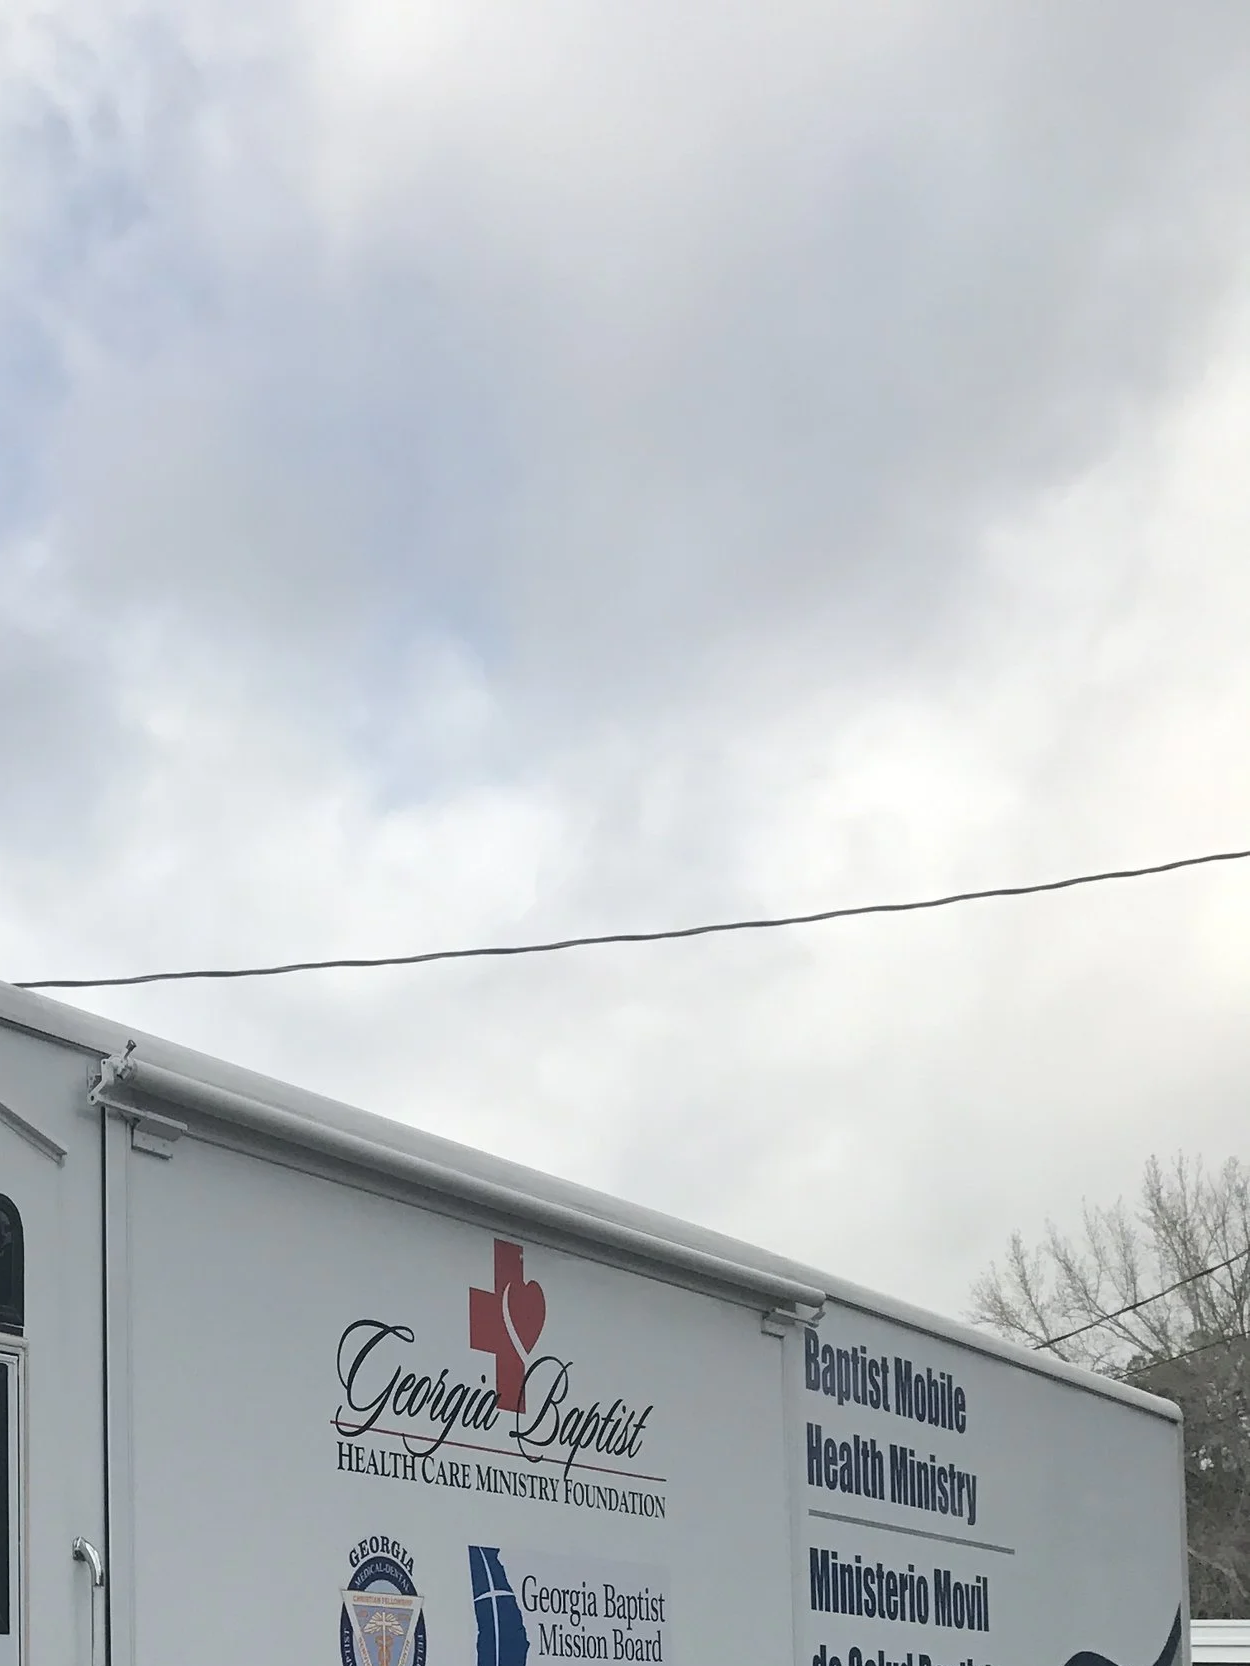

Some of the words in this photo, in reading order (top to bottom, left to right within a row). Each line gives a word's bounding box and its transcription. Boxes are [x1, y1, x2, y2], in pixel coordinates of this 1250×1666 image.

[336, 1319, 501, 1457] Georgia
[509, 1356, 653, 1478] Baptist
[804, 1328, 890, 1413] Baptist
[895, 1357, 966, 1433] Mobile
[336, 1441, 417, 1482] HEALTH
[421, 1455, 472, 1489] CARE
[475, 1464, 560, 1502] MINISTRY
[562, 1479, 667, 1519] FOUNDATION
[806, 1422, 885, 1501] Health
[889, 1444, 977, 1526] Ministry
[348, 1535, 415, 1577] GEORGIA
[354, 1563, 410, 1593] MEDICAL-DENTAL
[809, 1546, 929, 1625] Ministerio
[934, 1568, 990, 1632] Movil
[521, 1575, 598, 1626] Georgia
[603, 1584, 666, 1631] Baptist
[538, 1623, 608, 1660] Mission
[613, 1630, 663, 1662] Board
